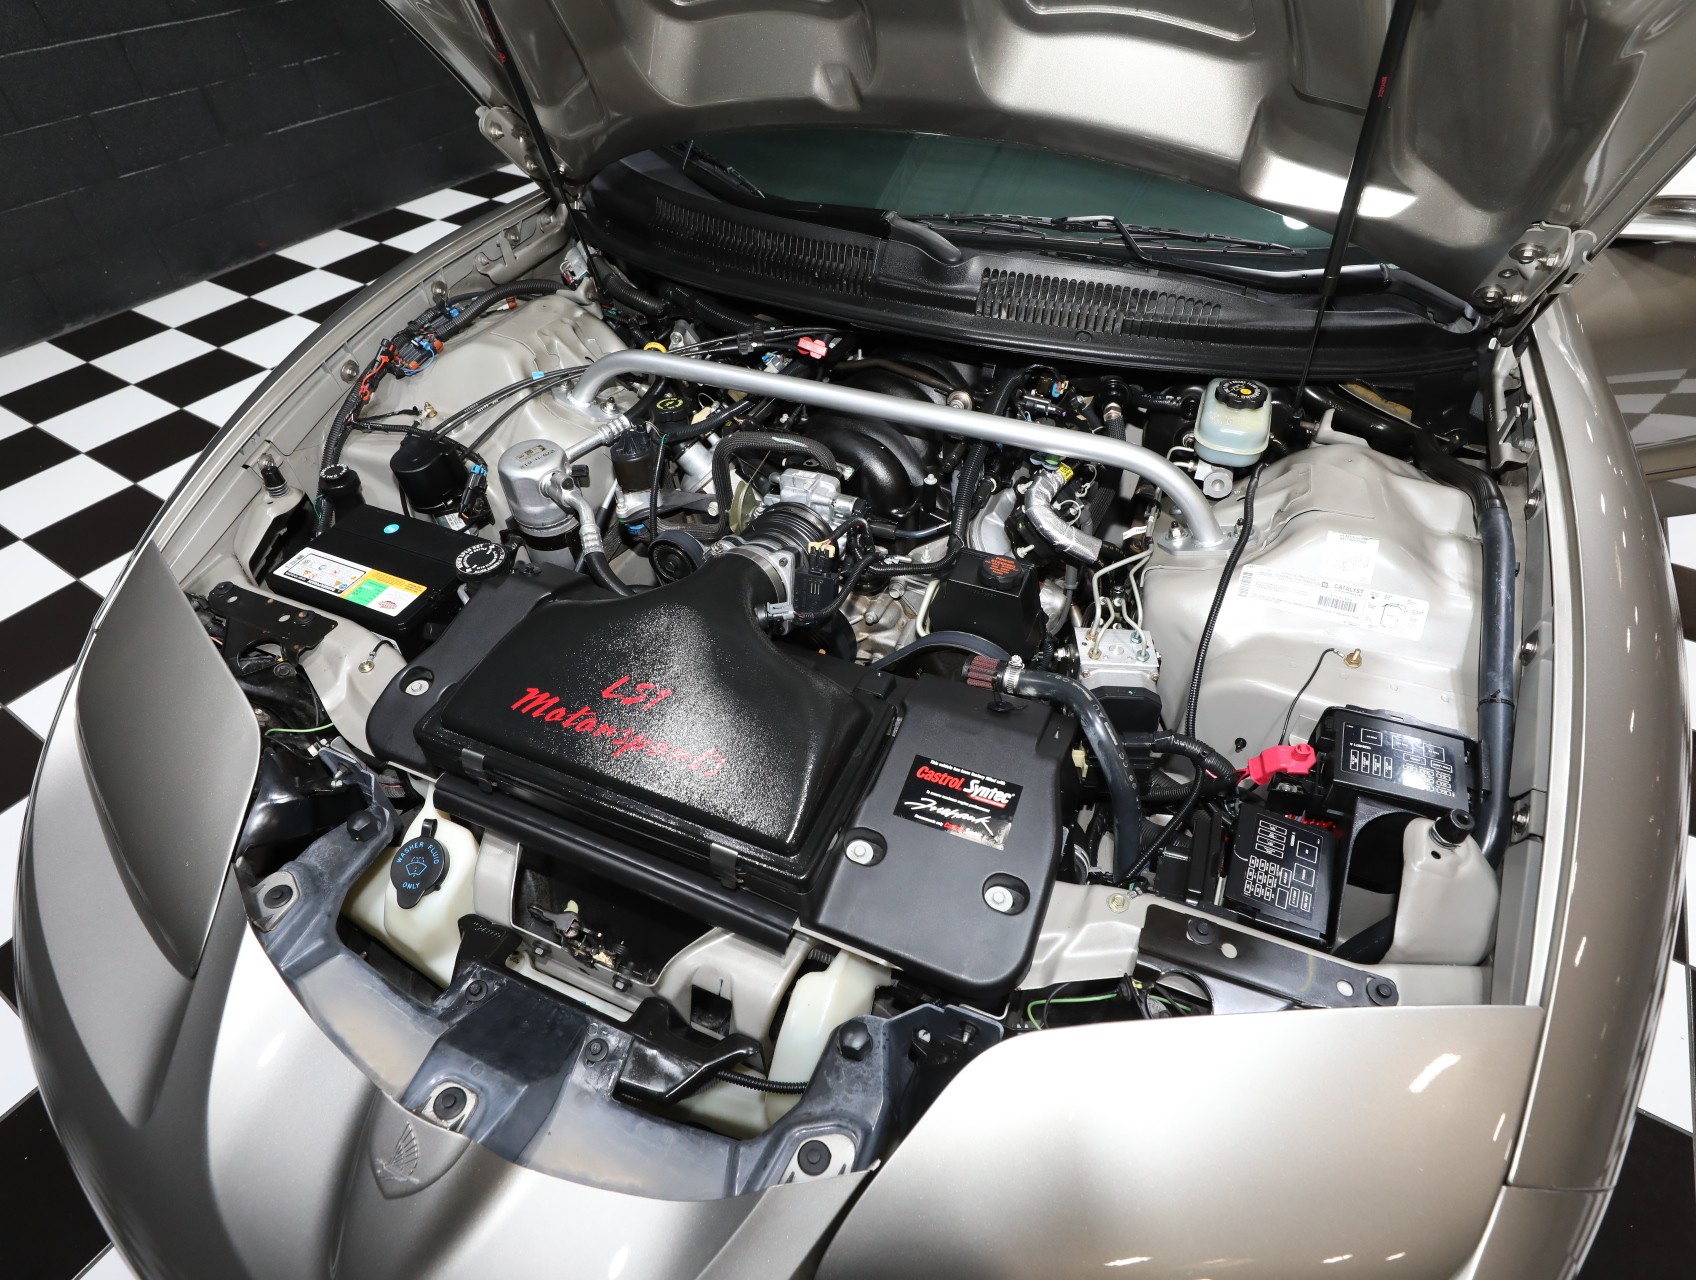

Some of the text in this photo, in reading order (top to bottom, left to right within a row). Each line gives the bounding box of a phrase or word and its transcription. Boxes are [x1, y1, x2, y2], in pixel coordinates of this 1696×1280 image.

[1334, 583, 1364, 594] CATALYST
[601, 675, 672, 710] LS1
[916, 765, 965, 790] Castrol
[963, 779, 1012, 804] Syntec
[396, 841, 440, 865] WASHER FLUID
[402, 881, 420, 890] ONLY
